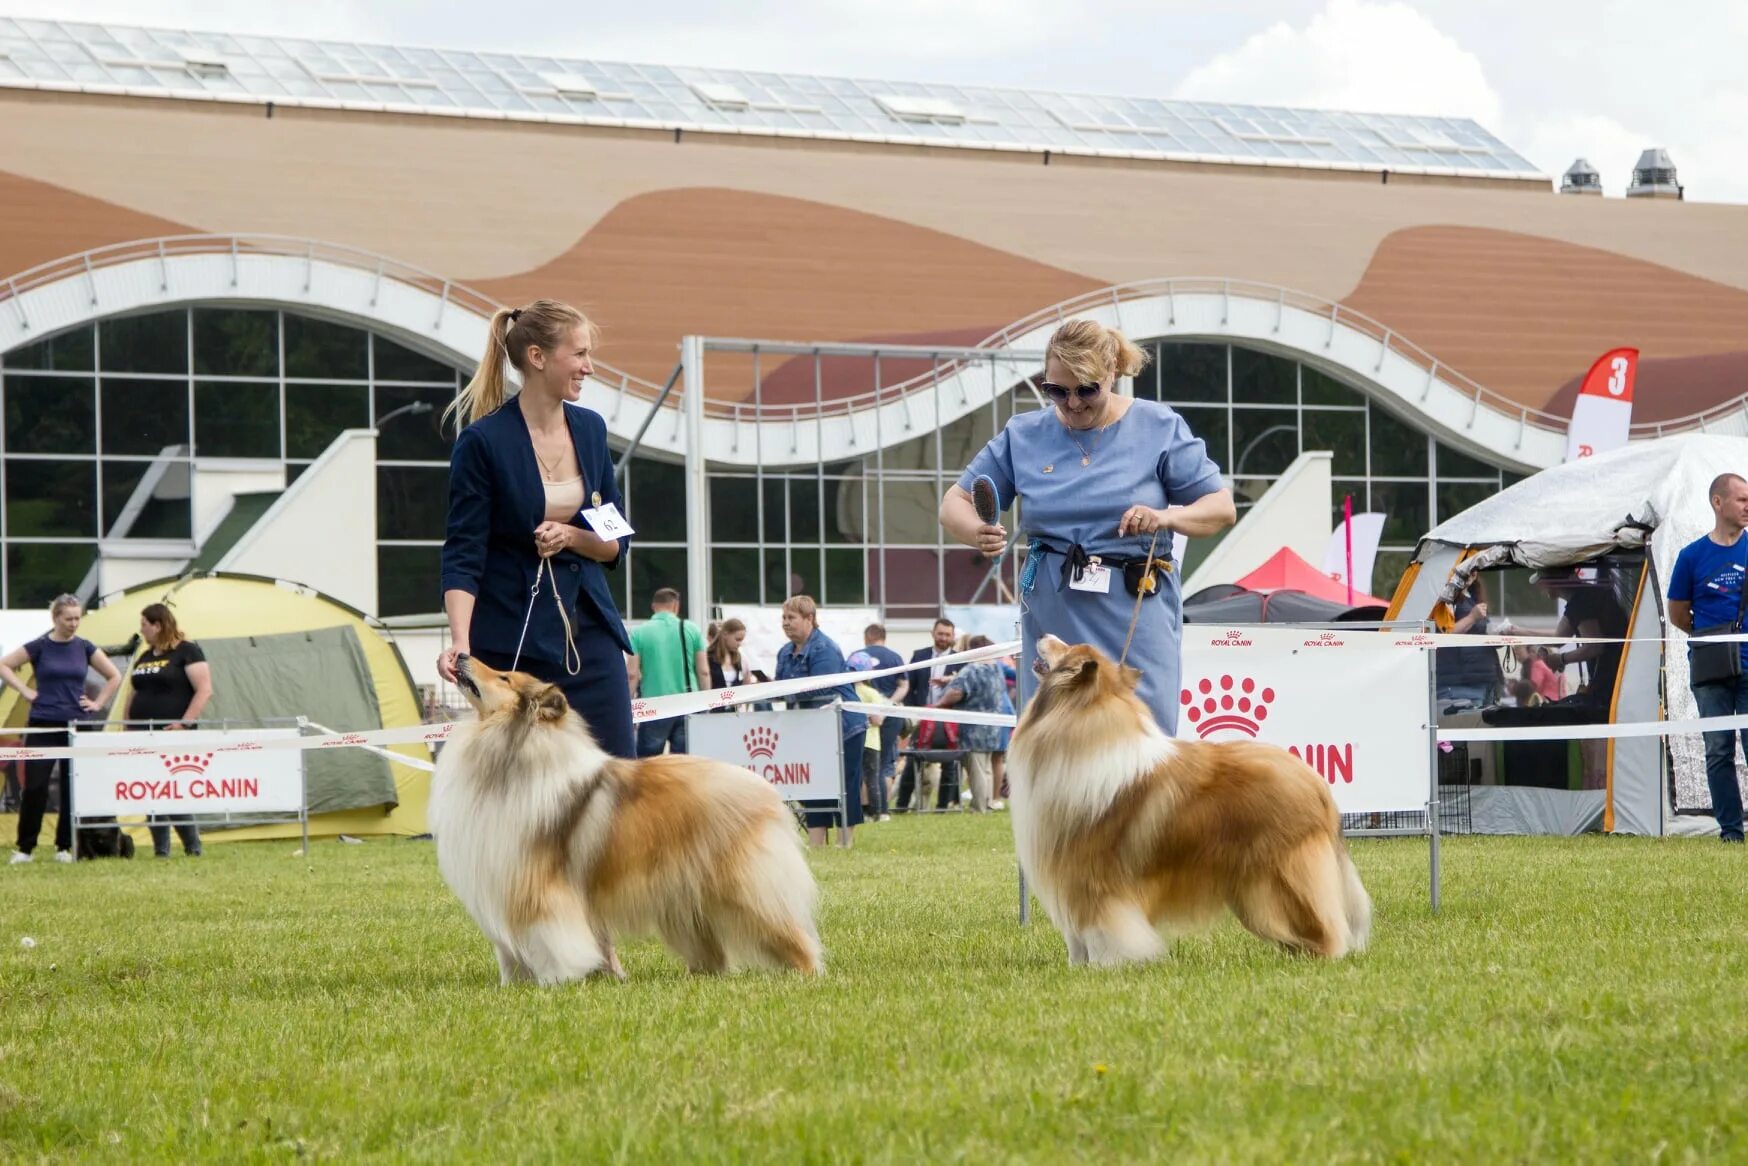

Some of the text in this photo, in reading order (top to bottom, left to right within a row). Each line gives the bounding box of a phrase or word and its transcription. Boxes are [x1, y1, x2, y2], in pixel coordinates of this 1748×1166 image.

[1608, 356, 1628, 396] 3
[763, 763, 811, 784] CANIN
[115, 778, 258, 800] ROYAL CANIN
